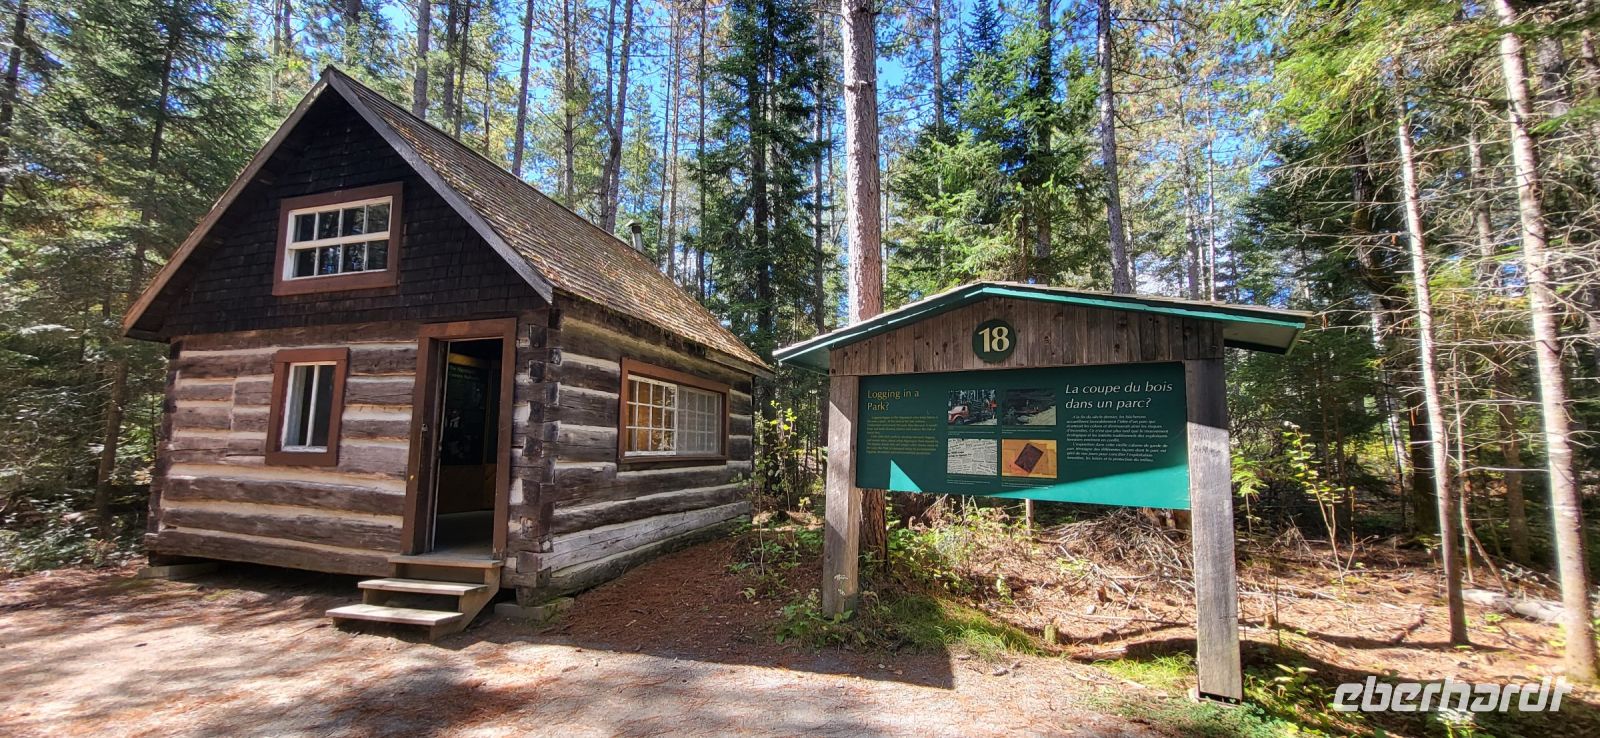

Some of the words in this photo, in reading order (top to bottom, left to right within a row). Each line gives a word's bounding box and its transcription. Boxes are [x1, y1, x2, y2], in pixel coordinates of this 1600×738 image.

[978, 326, 1010, 353] 18
[867, 389, 901, 400] Logging
[903, 388, 912, 397] in
[1065, 384, 1079, 394] La
[1082, 385, 1121, 396] coupe
[1124, 382, 1141, 393] du
[1145, 381, 1173, 392] bois
[867, 401, 890, 411] Park?
[1065, 398, 1093, 409] dans
[1097, 400, 1113, 409] un
[1116, 397, 1152, 411] parc?
